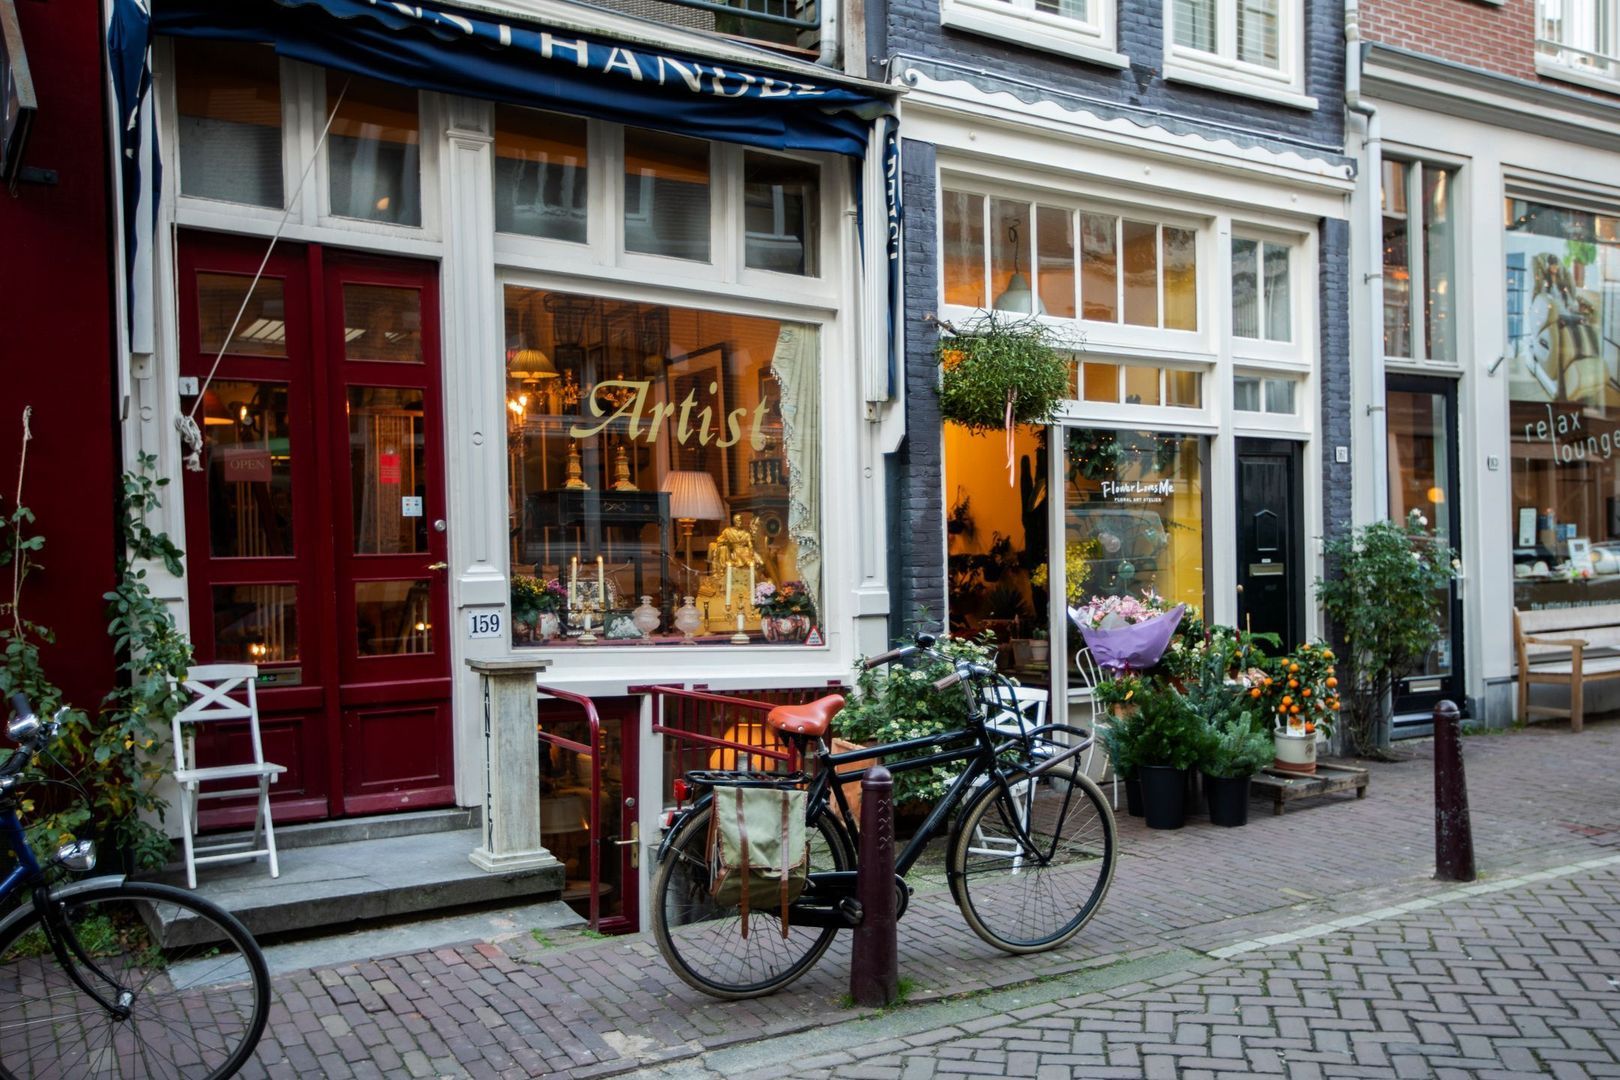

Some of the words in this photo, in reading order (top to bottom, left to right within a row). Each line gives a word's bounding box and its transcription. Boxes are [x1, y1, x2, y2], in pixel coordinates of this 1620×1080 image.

[569, 380, 770, 451] Artist
[1524, 403, 1581, 452] relax
[230, 459, 265, 471] OPEN
[471, 613, 500, 634] 159
